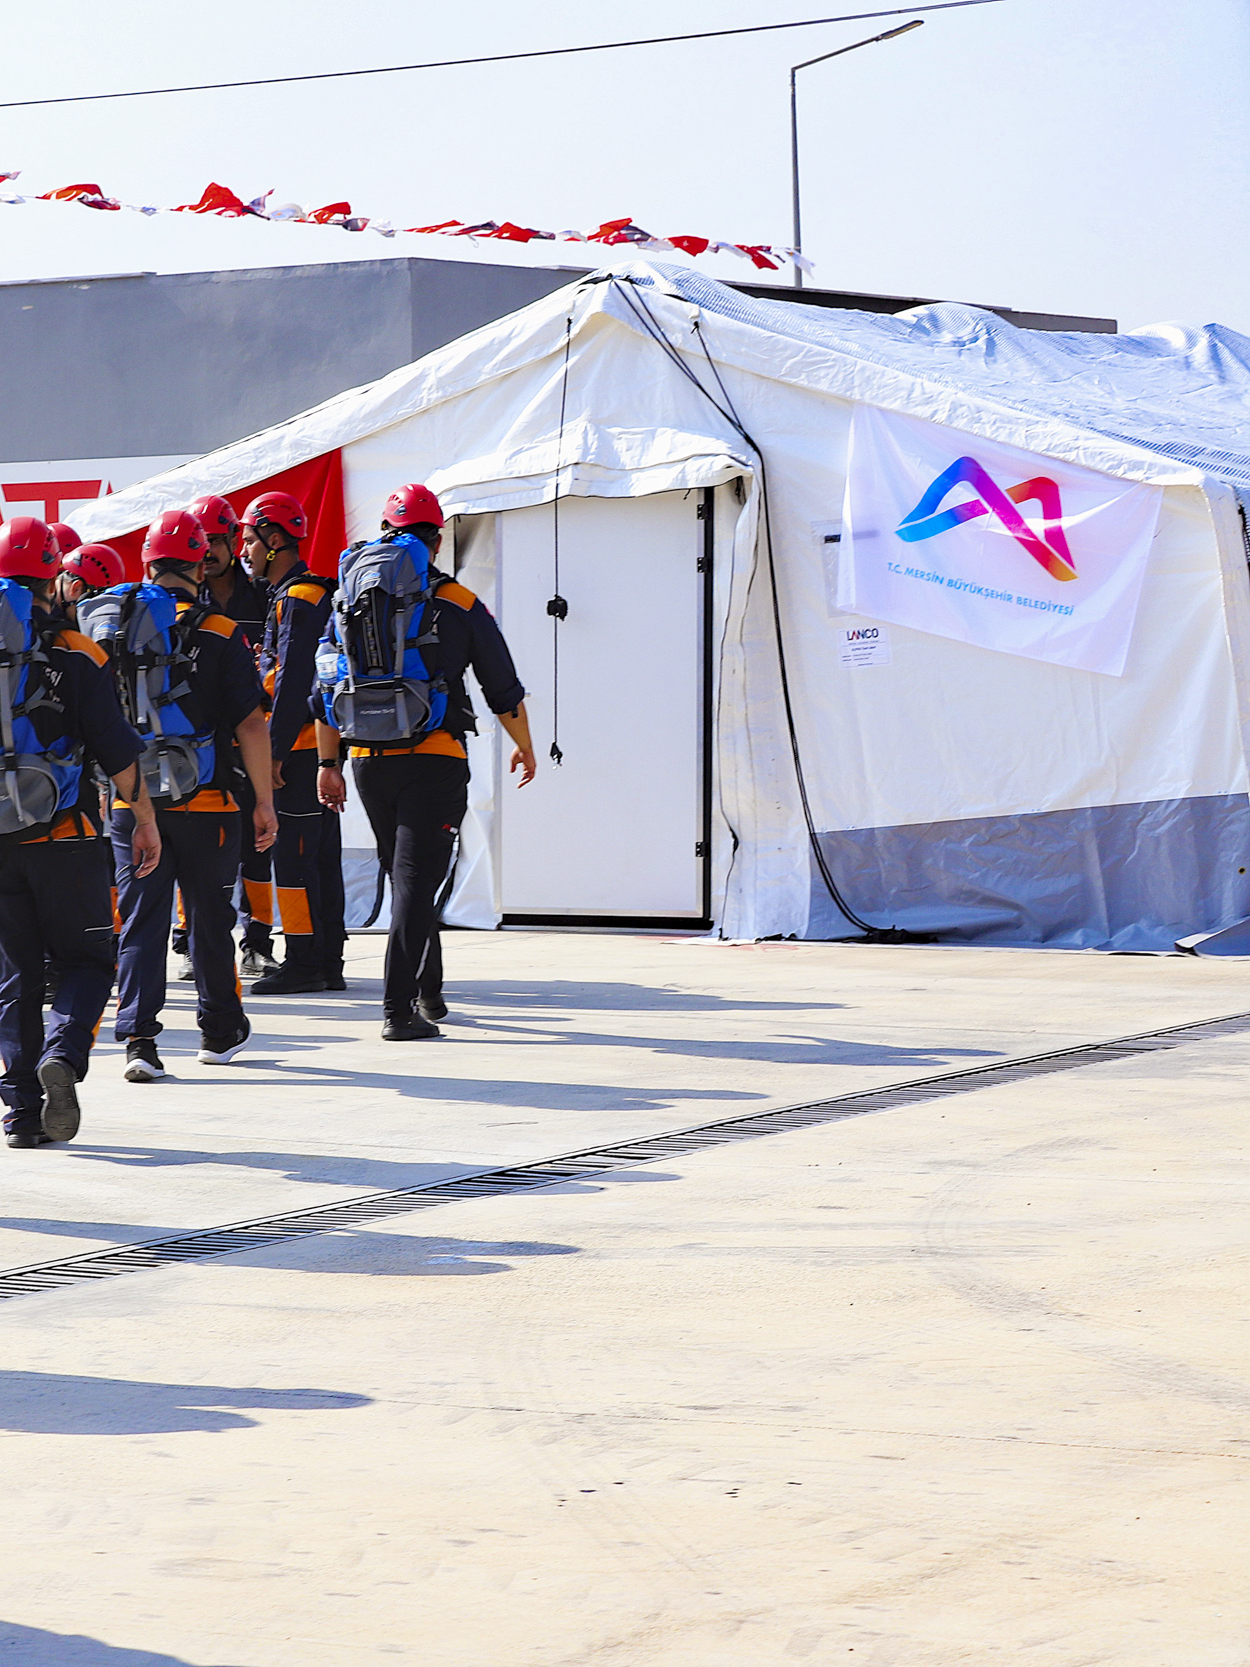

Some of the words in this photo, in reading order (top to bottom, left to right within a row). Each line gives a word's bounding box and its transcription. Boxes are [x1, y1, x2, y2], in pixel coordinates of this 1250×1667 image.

[904, 566, 944, 585] MERSİN
[947, 578, 1013, 603] BÜYÜKŞEHİR
[1016, 596, 1075, 616] BELEDİYESİ
[846, 628, 879, 641] LANCO
